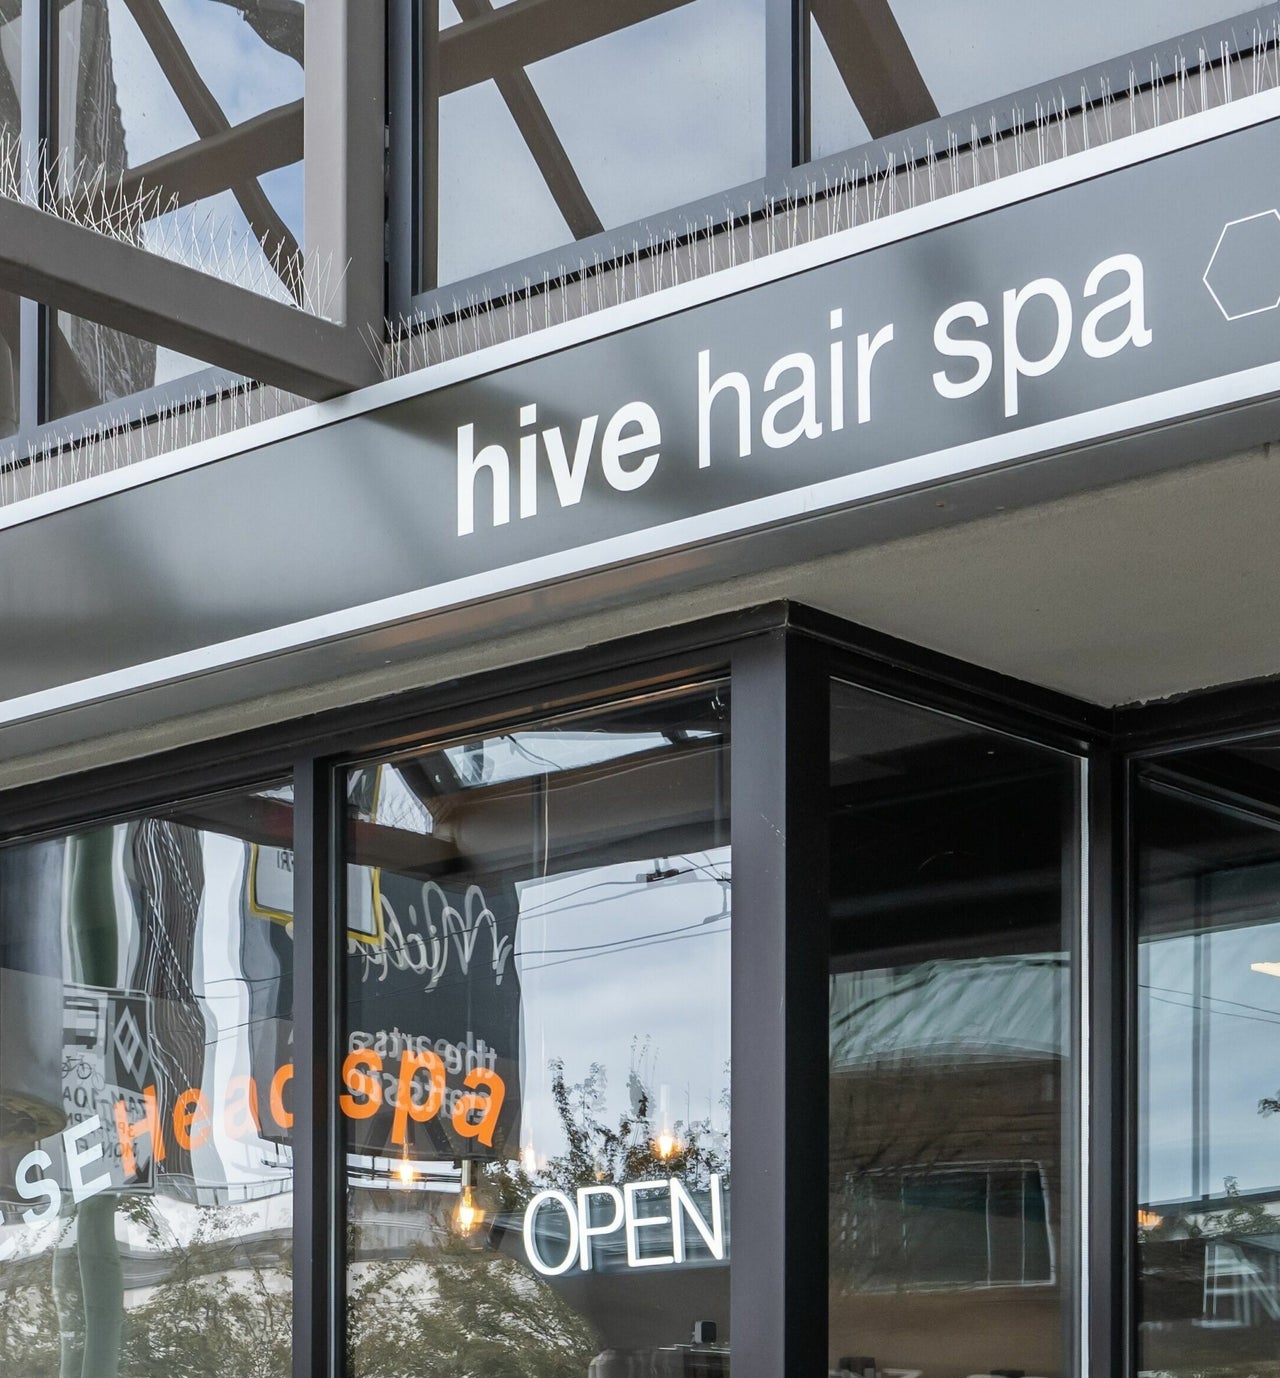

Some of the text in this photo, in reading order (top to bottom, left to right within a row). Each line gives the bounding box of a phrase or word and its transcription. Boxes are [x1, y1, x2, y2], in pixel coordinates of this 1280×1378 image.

[456, 252, 1153, 537] hive hair spa
[522, 1173, 726, 1276] OPEN
